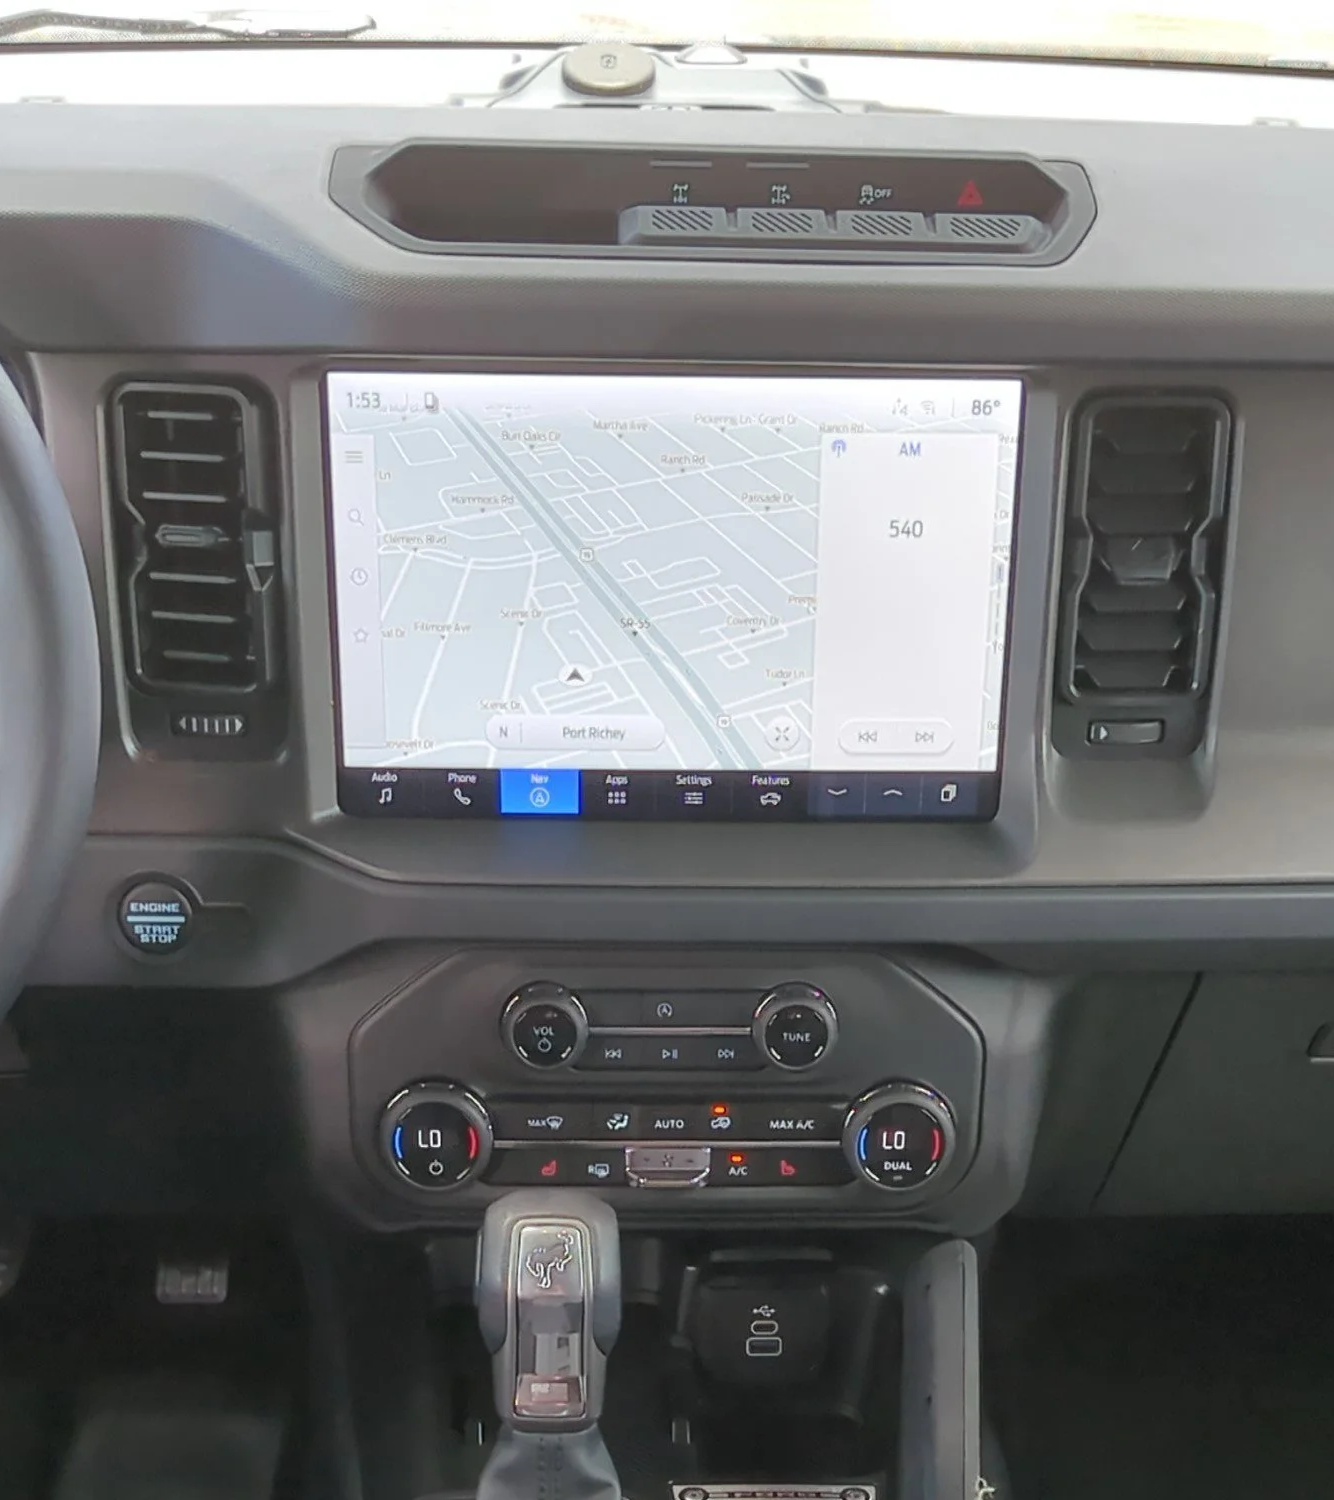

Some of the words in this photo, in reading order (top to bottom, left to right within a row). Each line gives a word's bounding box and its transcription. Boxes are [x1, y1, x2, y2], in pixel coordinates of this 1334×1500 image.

[874, 188, 892, 199] OFF
[347, 392, 381, 408] 1:53
[971, 400, 1001, 416] 86°
[899, 442, 921, 456] AM
[889, 520, 924, 538] 540
[500, 727, 508, 738] N
[563, 727, 586, 738] Port
[589, 726, 626, 740] Richey
[371, 772, 398, 782] Audio
[447, 773, 477, 783] Phone
[531, 774, 549, 783] Nav
[605, 774, 628, 786] Apps
[675, 775, 713, 787] Settings
[752, 775, 790, 785] Features
[130, 902, 181, 912] ENGINE
[134, 924, 181, 934] START
[140, 934, 177, 943] STOP
[533, 1026, 554, 1036] VOL
[782, 1032, 811, 1042] TUNE
[654, 1119, 684, 1129] AUTO
[770, 1120, 794, 1129] MAX
[796, 1120, 815, 1130] A/C
[418, 1129, 442, 1148] LO
[882, 1131, 906, 1150] LO
[728, 1166, 748, 1176] A/C
[883, 1161, 913, 1171] DUAL
